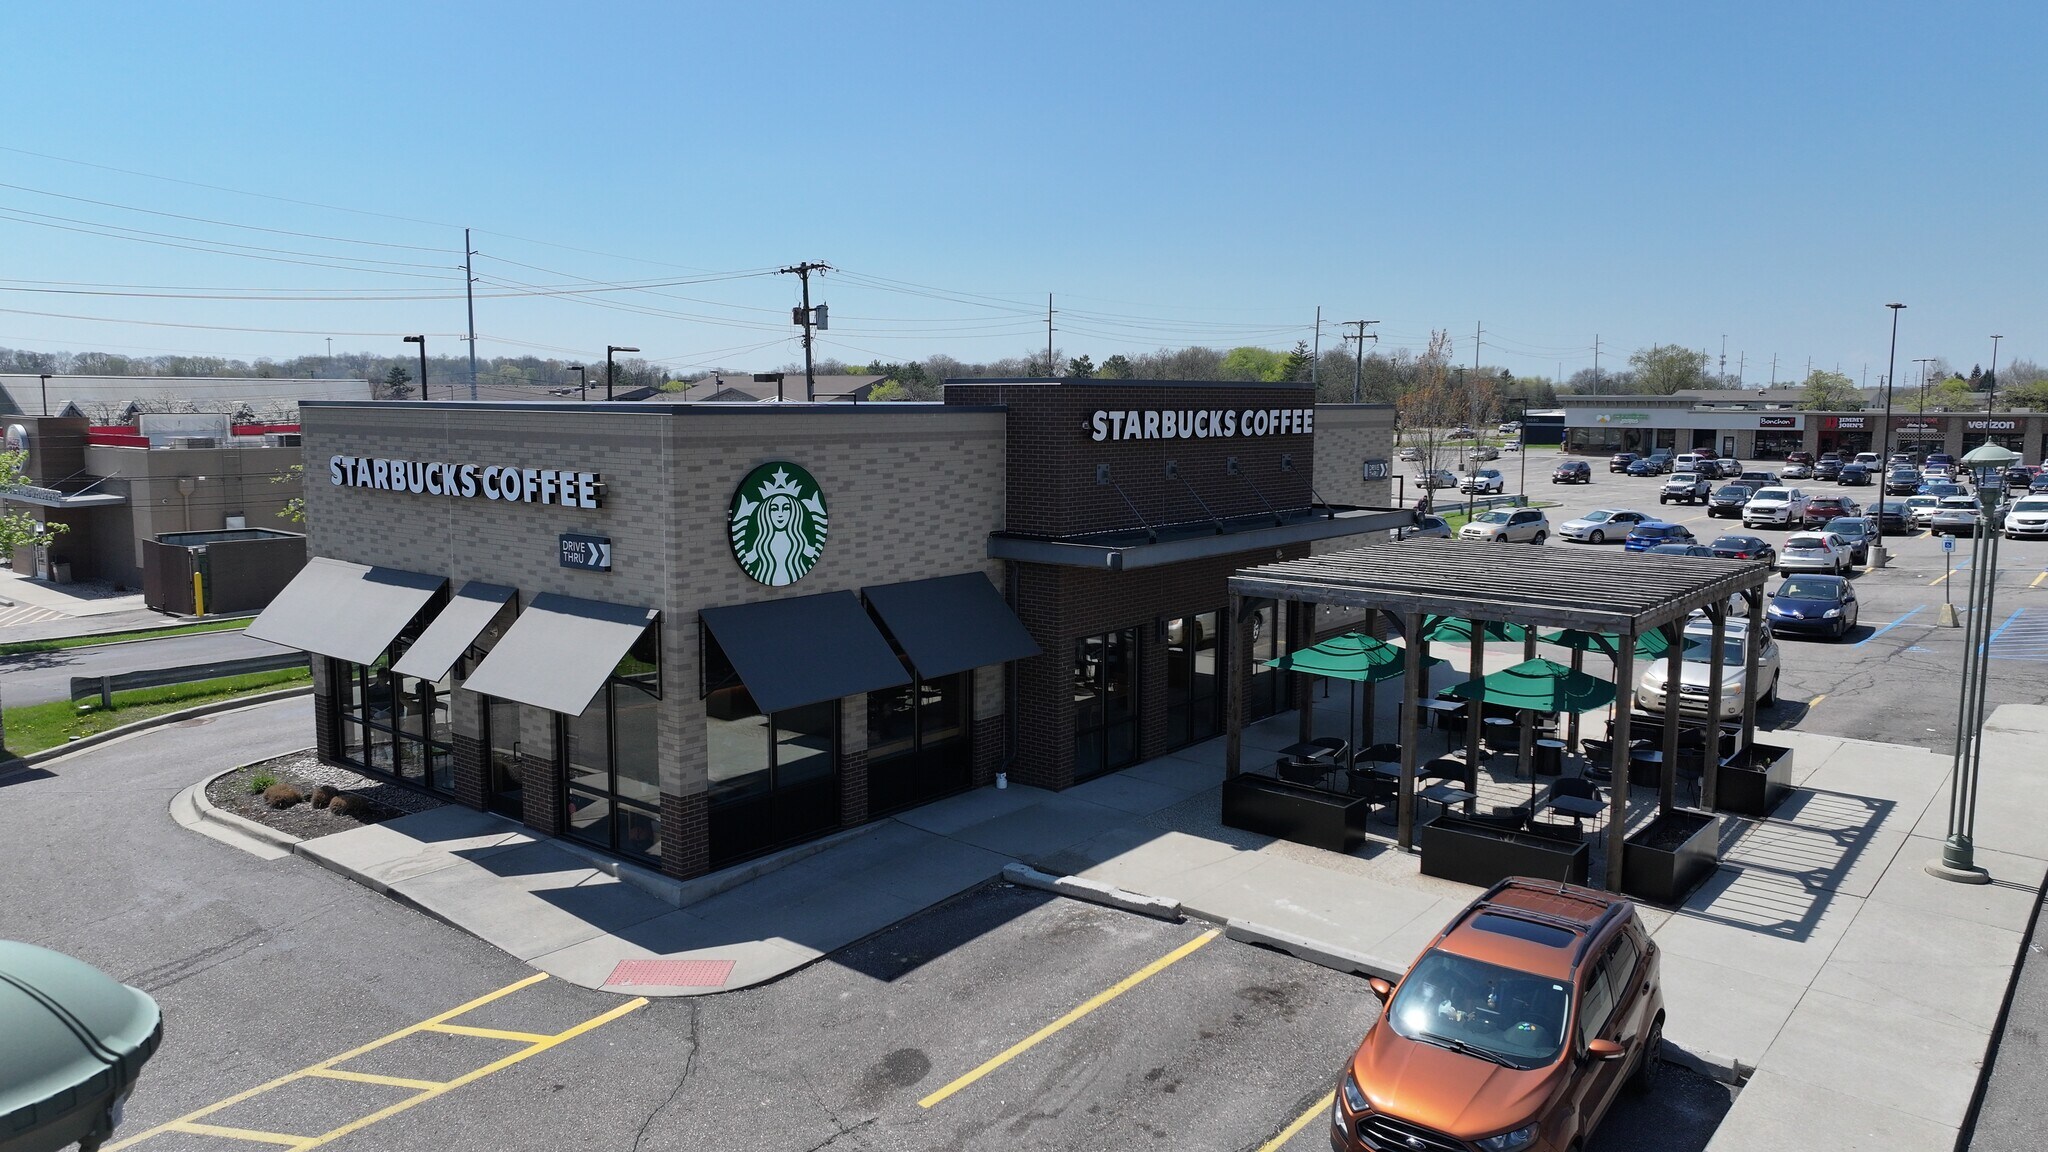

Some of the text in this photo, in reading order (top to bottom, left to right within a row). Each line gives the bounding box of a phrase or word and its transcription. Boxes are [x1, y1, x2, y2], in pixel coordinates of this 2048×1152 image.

[1092, 409, 1313, 441] STARBUCKS COFFEE
[1967, 419, 2016, 429] verizon
[329, 454, 601, 509] STARBUCKS COFFEE
[562, 540, 586, 553] DRIVE
[563, 551, 584, 564] THRU
